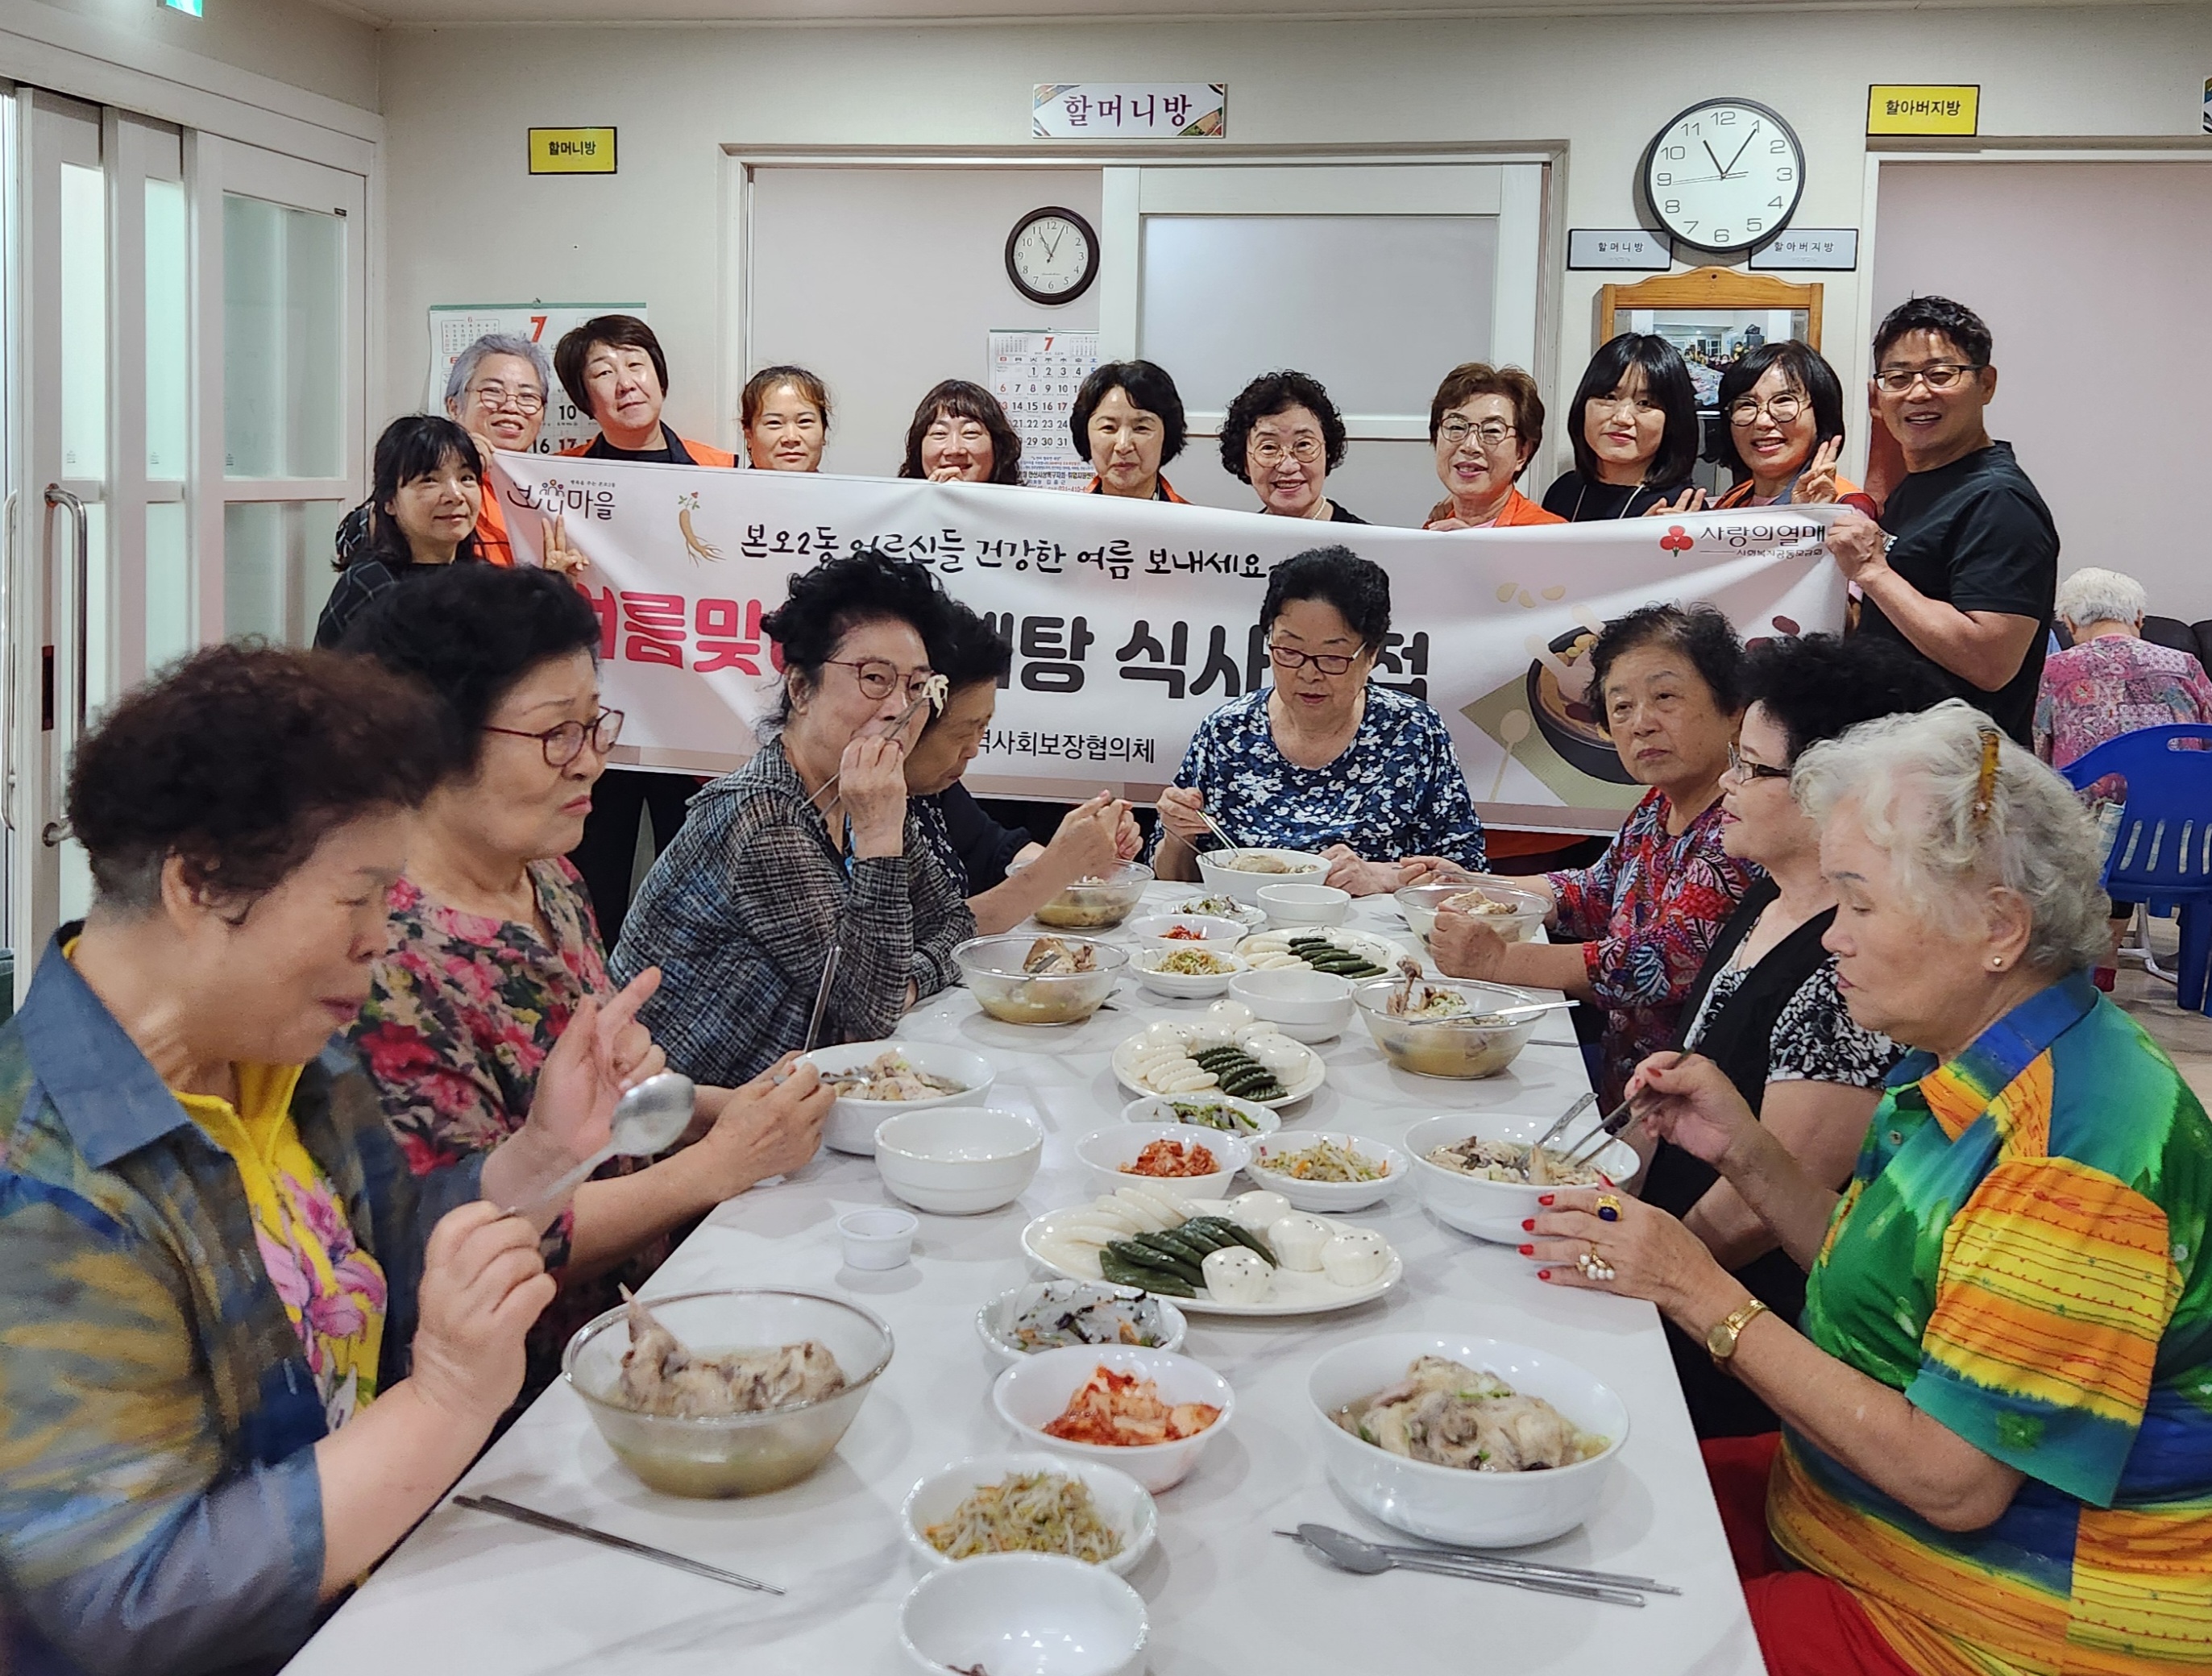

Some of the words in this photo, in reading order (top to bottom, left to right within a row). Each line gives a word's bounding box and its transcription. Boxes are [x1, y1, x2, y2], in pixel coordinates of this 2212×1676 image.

[1063, 93, 1193, 127] 할머니방
[1886, 99, 1961, 116] 할아버지방
[1710, 111, 1736, 126] 12
[1680, 122, 1699, 136] 11
[1751, 120, 1760, 133] 1
[549, 140, 596, 156] 할머니방
[1661, 146, 1685, 160] 10
[1770, 139, 1786, 154] 2
[1657, 172, 1671, 186] 9
[1777, 167, 1792, 181] 3
[1665, 200, 1680, 214] 8
[1767, 196, 1783, 209] 4
[1032, 226, 1042, 234] 11
[1047, 221, 1057, 230] 12
[1064, 226, 1069, 234] 1
[1683, 221, 1699, 234] 7
[1747, 218, 1762, 232] 5
[1023, 238, 1032, 247] 10
[1075, 238, 1081, 247] 2
[1714, 229, 1729, 243] 6
[1598, 242, 1644, 252] 할머니방
[1774, 242, 1834, 252] 할아버지방
[1018, 251, 1023, 260] 9
[1078, 251, 1084, 260] 3
[1023, 265, 1028, 274] 8
[1073, 265, 1079, 274] 4
[1033, 276, 1039, 284] 7
[1048, 280, 1054, 289] 6
[1064, 276, 1069, 285] 5
[530, 316, 548, 342] 7
[1044, 337, 1054, 351] 7
[1031, 367, 1035, 375] 1
[1045, 367, 1052, 375] 2
[1060, 367, 1067, 375] 3
[1075, 367, 1081, 375] 4
[1000, 384, 1006, 392] 6
[1015, 384, 1021, 392] 7
[1030, 384, 1036, 392] 8
[1044, 384, 1051, 392] 9
[1058, 384, 1069, 393] 10
[558, 404, 577, 421] 10
[1012, 402, 1023, 411] 14
[1027, 402, 1038, 411] 15
[1042, 402, 1053, 411] 16
[1057, 402, 1068, 411] 17
[1012, 420, 1023, 428] 21
[1027, 420, 1039, 428] 22
[1041, 420, 1053, 428] 23
[1056, 420, 1069, 429] 24
[533, 438, 550, 454] 16
[1027, 437, 1038, 446] 29
[1041, 438, 1053, 446] 30
[1057, 438, 1068, 446] 31
[1700, 525, 1825, 547] 사랑의열매
[741, 524, 839, 570] 본오2동
[850, 529, 965, 573] 어르신들
[976, 539, 1066, 574] 건강한
[1077, 539, 1134, 580] 여름
[576, 583, 785, 675] 름맞
